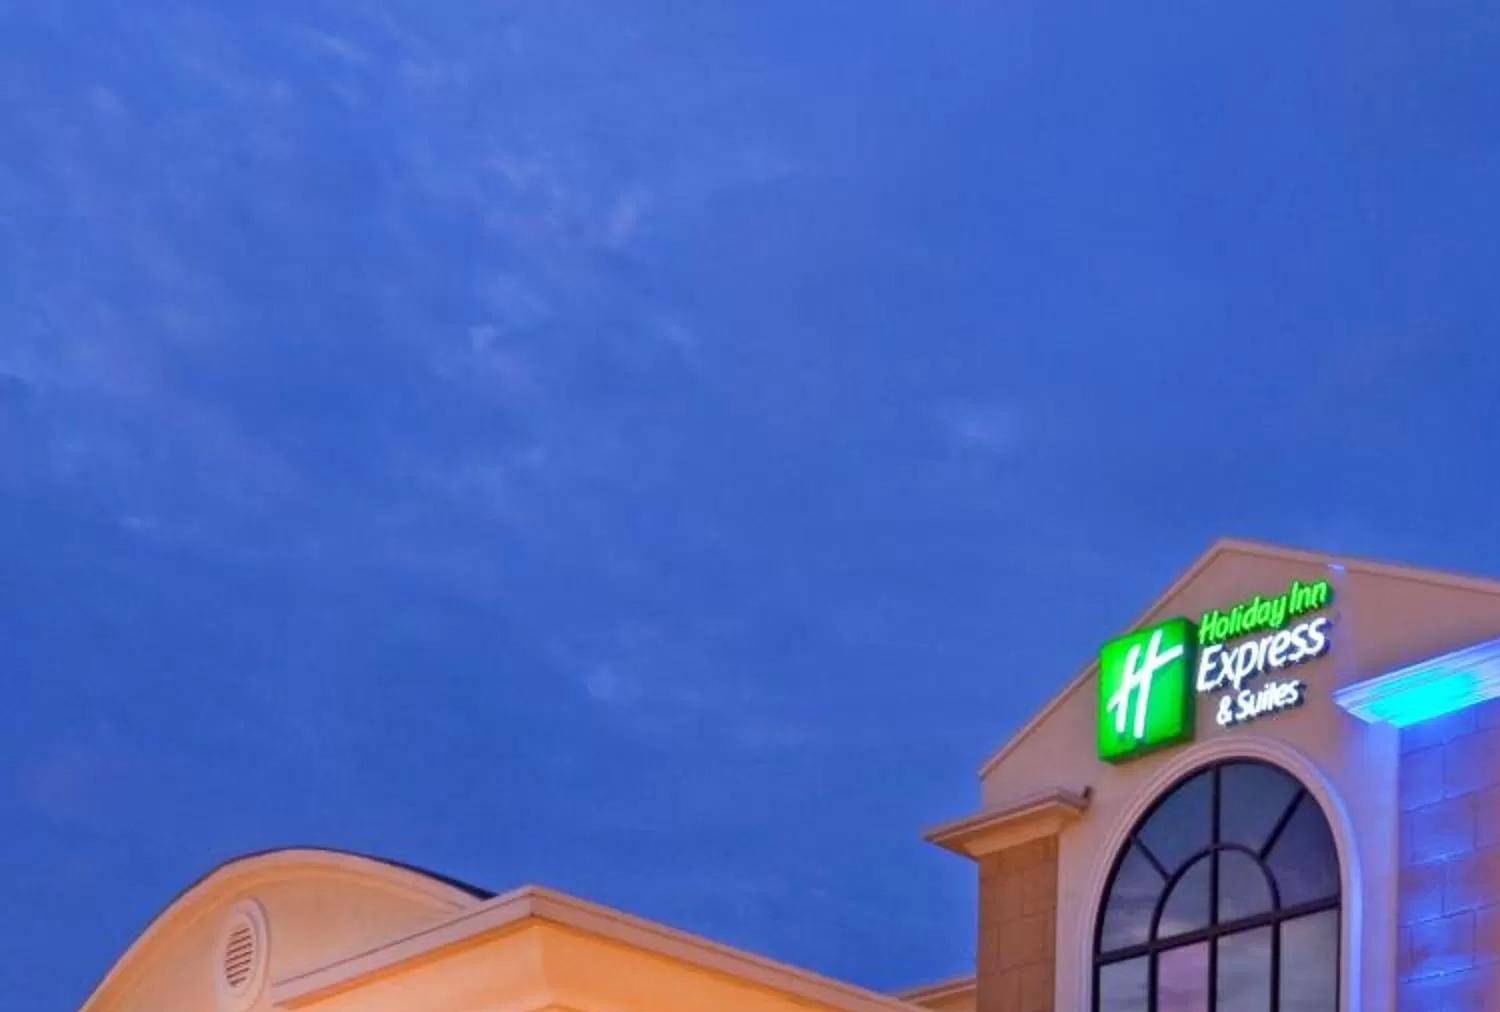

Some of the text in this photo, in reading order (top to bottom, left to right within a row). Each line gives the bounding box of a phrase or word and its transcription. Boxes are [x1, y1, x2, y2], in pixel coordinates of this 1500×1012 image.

[1198, 580, 1327, 645] Holiday Inn
[1197, 616, 1327, 692] Express
[1216, 679, 1300, 725] & Suites
